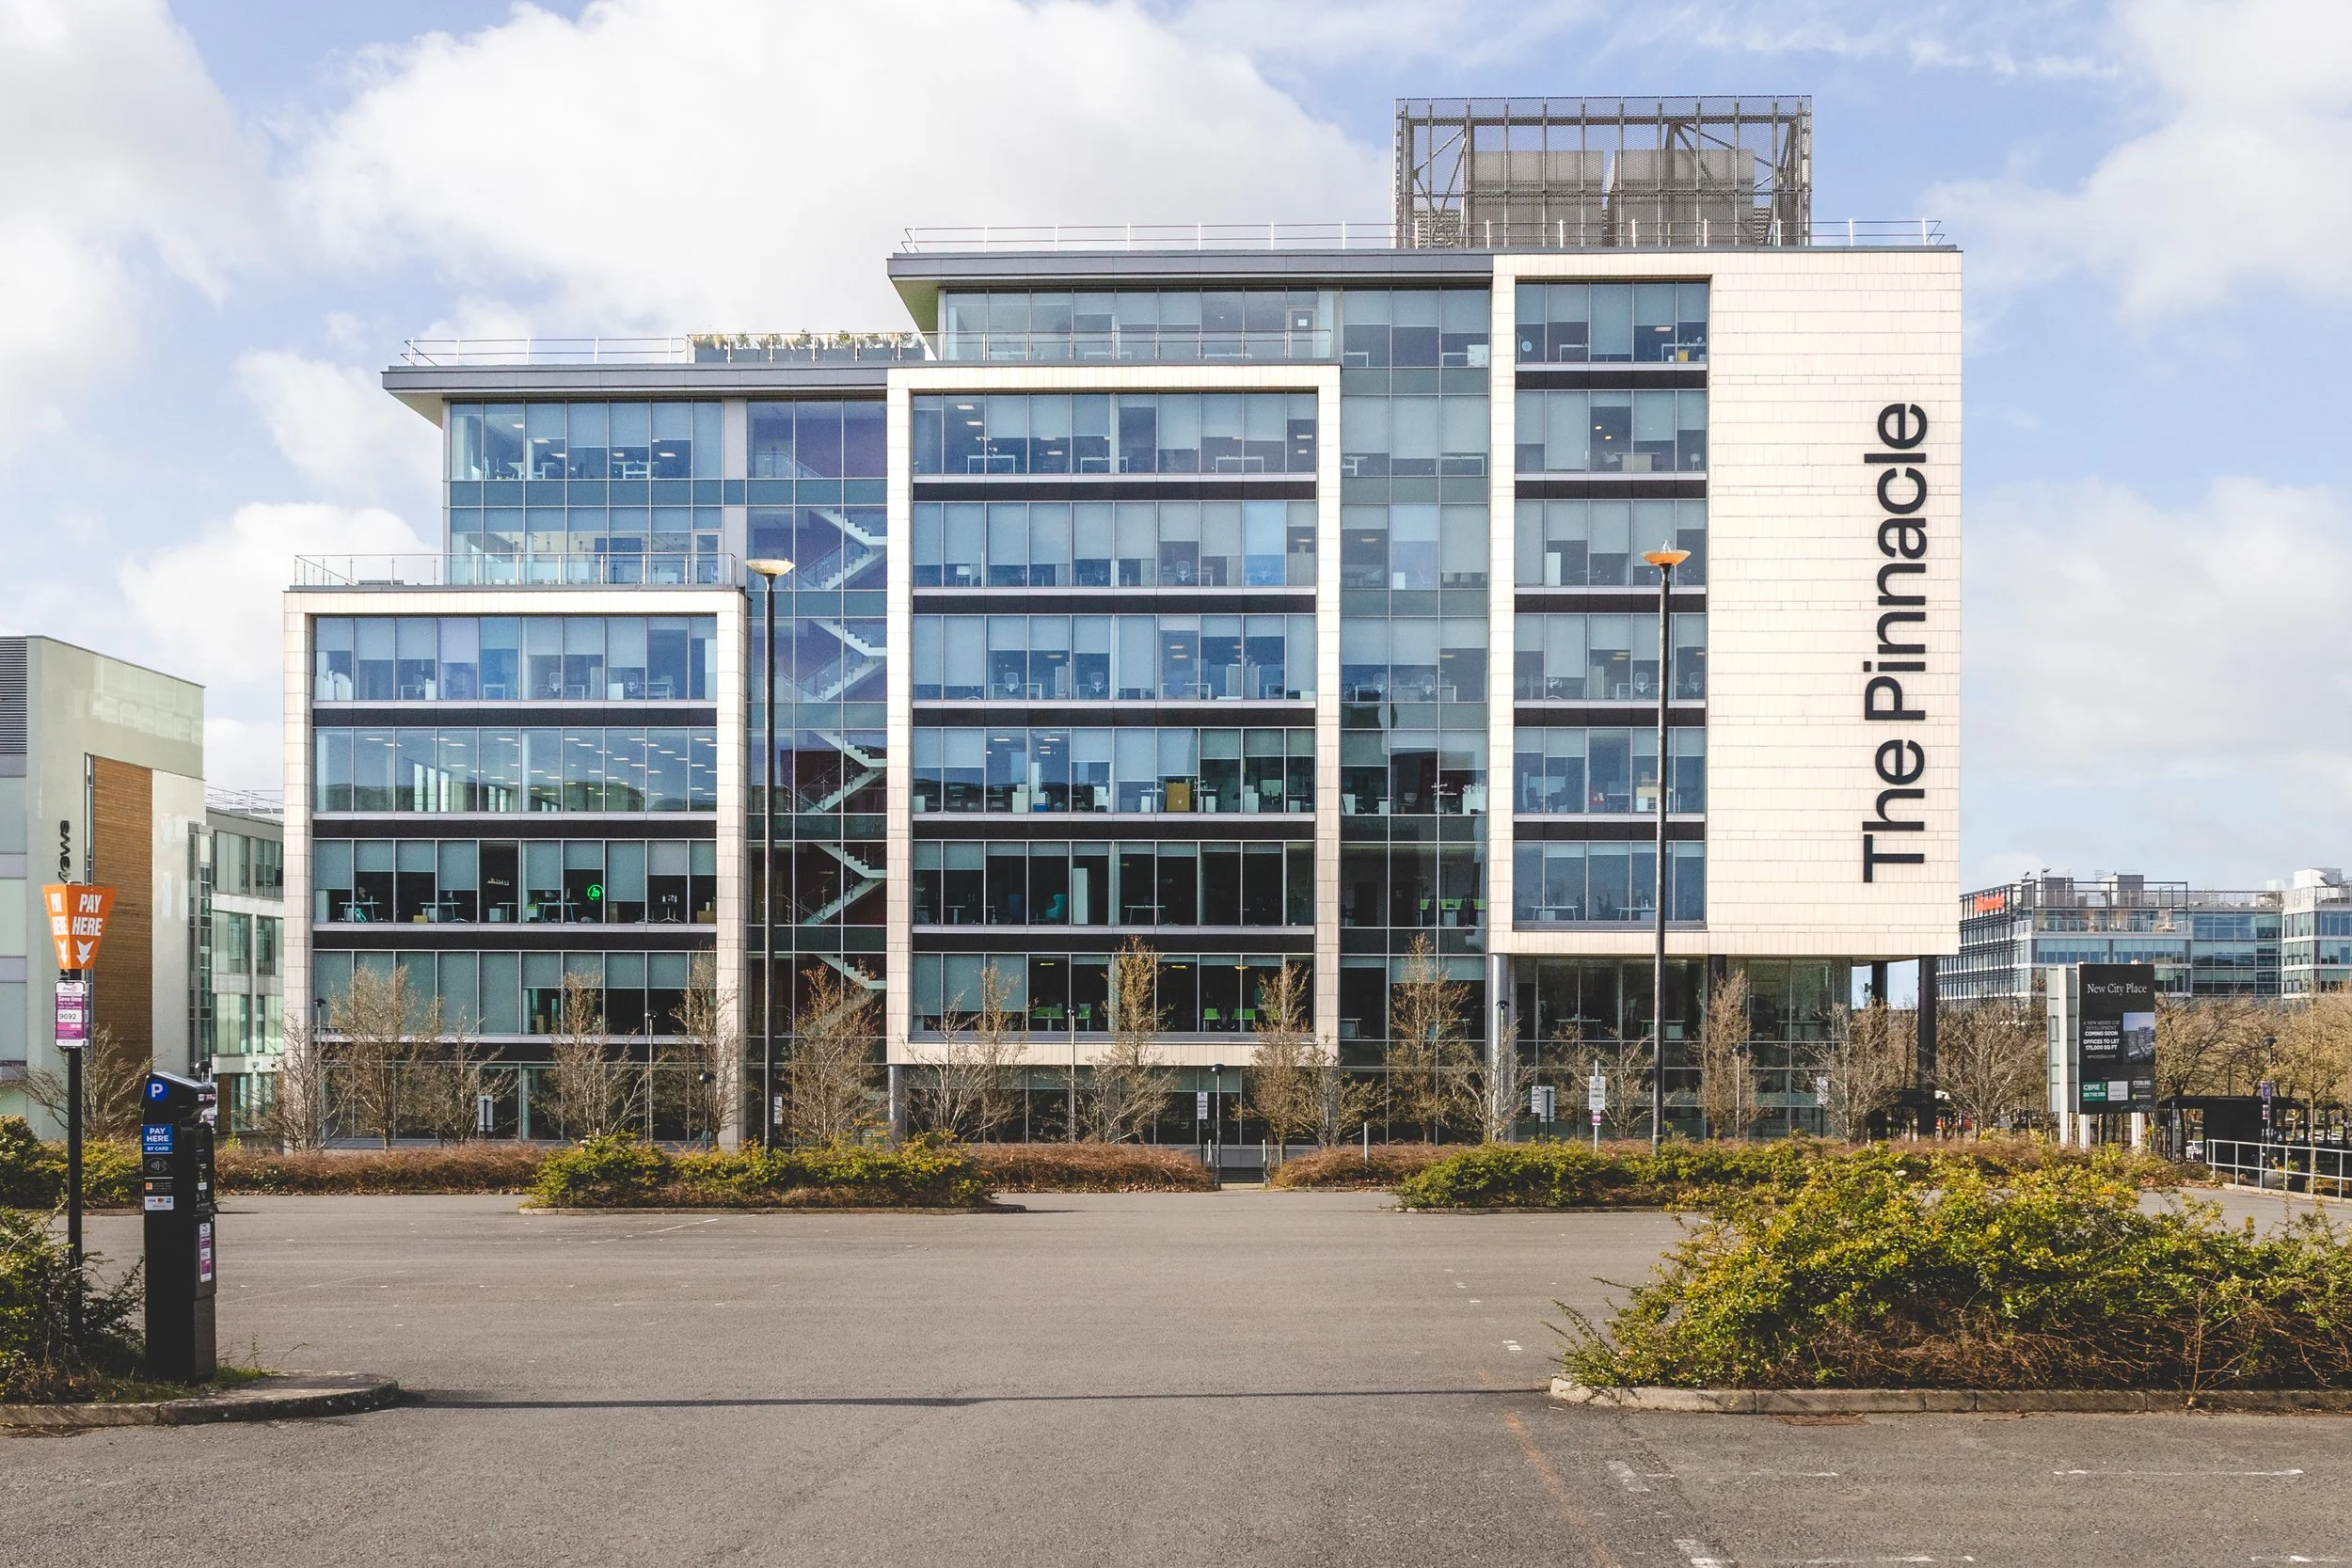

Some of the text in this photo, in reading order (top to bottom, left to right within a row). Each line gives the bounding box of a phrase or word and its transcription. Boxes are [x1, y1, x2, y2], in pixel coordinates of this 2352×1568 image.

[1863, 403, 1928, 883] The Pinnacle
[79, 894, 102, 913] PAY
[72, 916, 103, 937] HERE
[2087, 982, 2148, 996] New City Place
[151, 1083, 163, 1098] P
